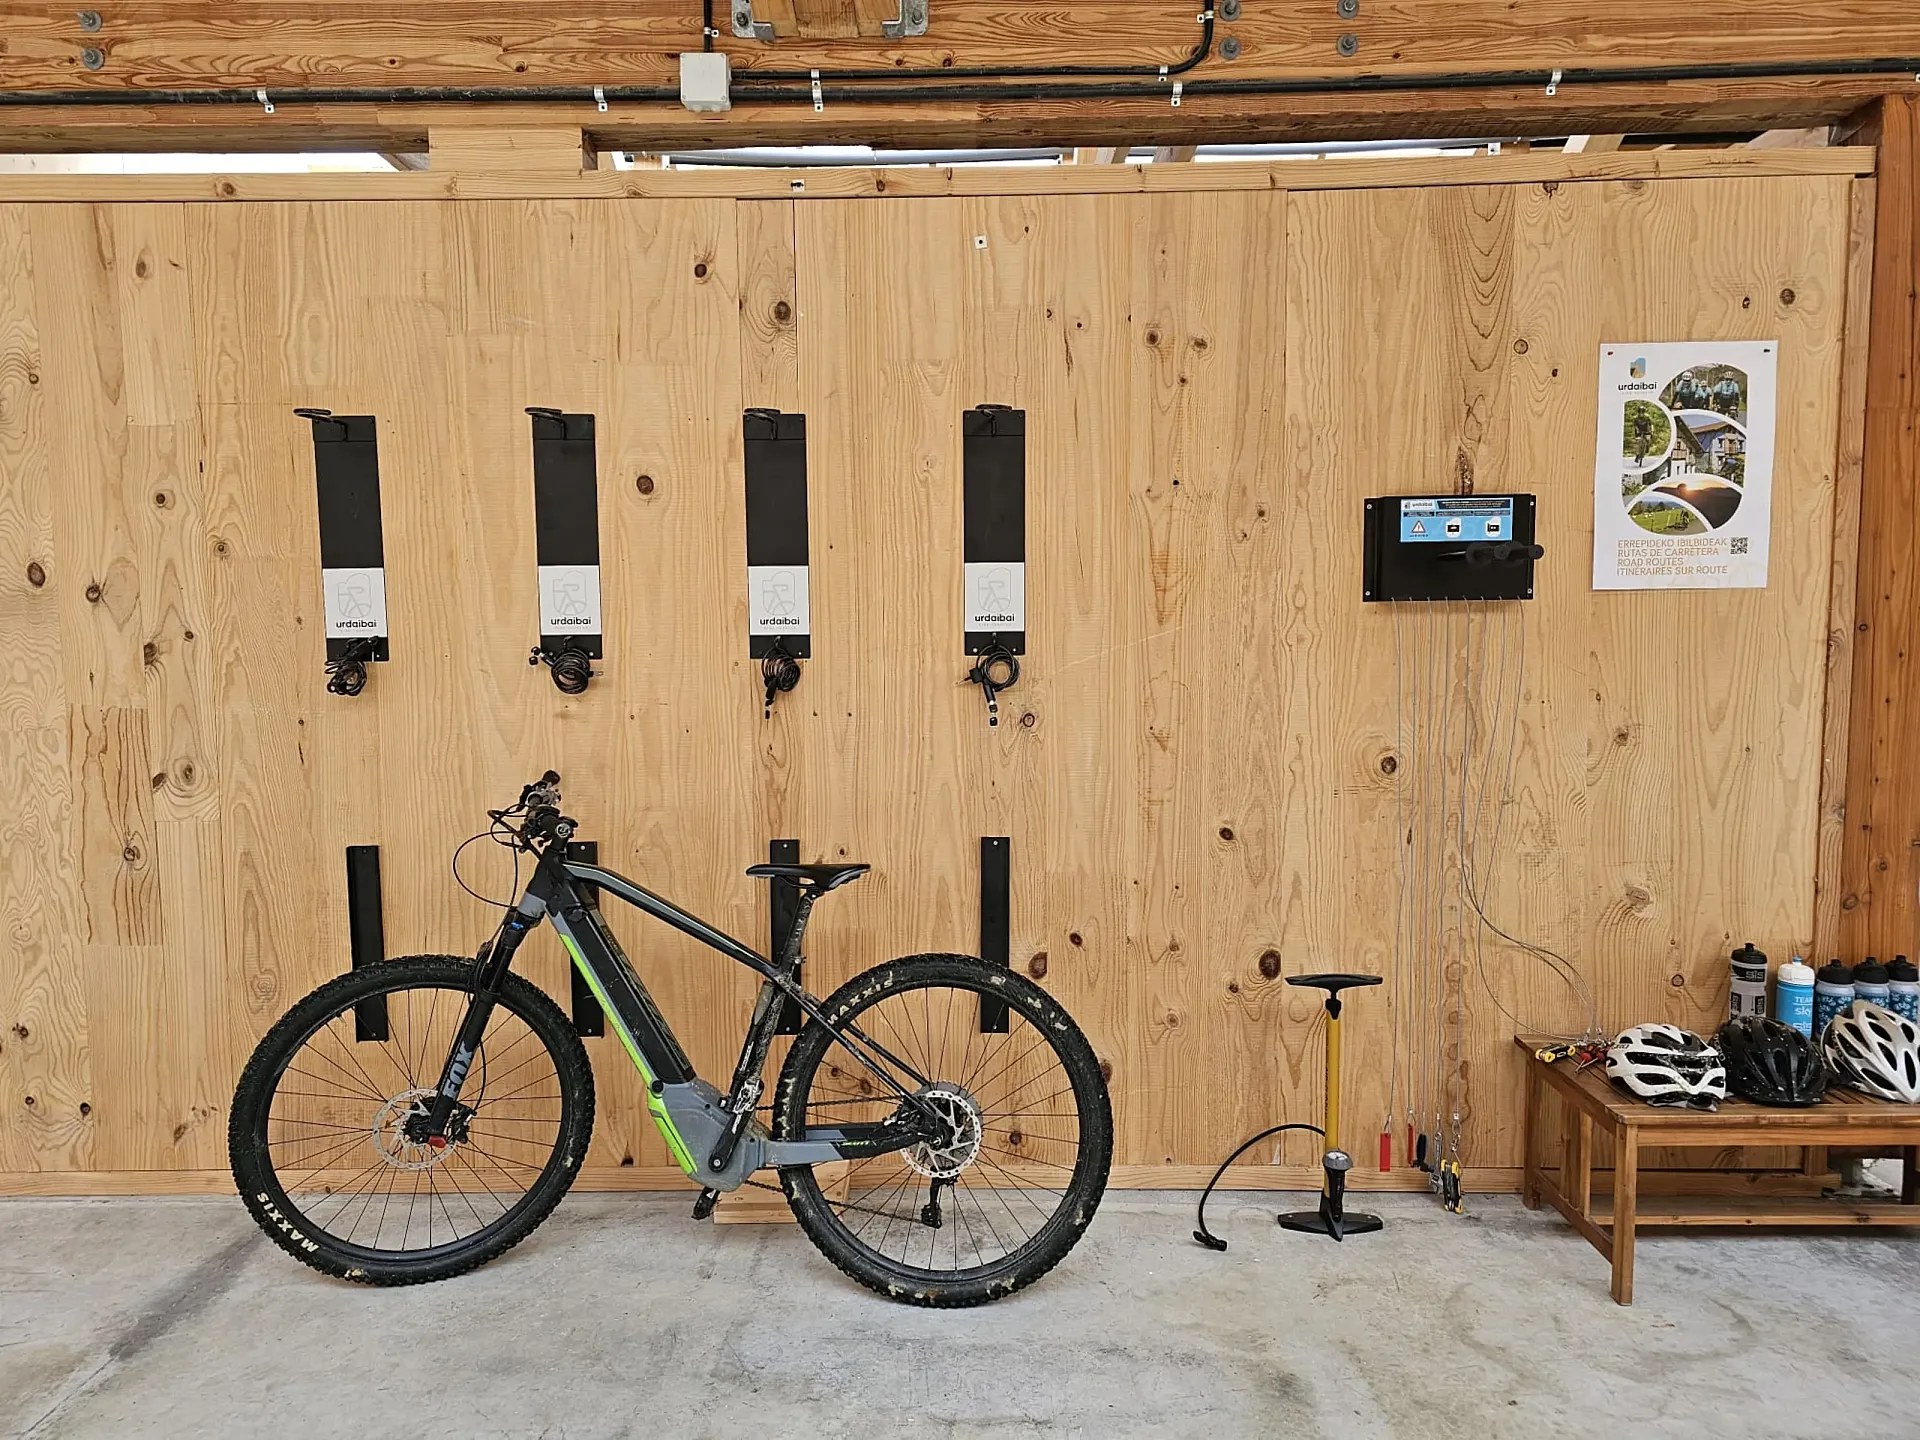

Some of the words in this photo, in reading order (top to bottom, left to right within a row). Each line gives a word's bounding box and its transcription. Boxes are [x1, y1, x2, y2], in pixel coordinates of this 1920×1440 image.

[1617, 381, 1658, 391] urdaibai
[1617, 539, 1674, 549] ERREPIDEKO
[1677, 537, 1727, 547] IBILBIDEAK
[1617, 548, 1648, 558] RUTAS
[1649, 548, 1661, 557] DE
[1664, 547, 1720, 557] CARRETERA
[1617, 557, 1643, 567] ROAD
[1645, 557, 1684, 567] ROUTES
[1674, 566, 1694, 576] SUR
[1696, 565, 1728, 575] ROUTE
[550, 616, 591, 625] urdaibai
[759, 616, 800, 625] urdaibai
[974, 613, 1015, 622] urdaibai
[335, 619, 377, 628] urdaibai
[442, 1040, 473, 1102] FOX
[256, 1192, 320, 1253] MAXXIS
